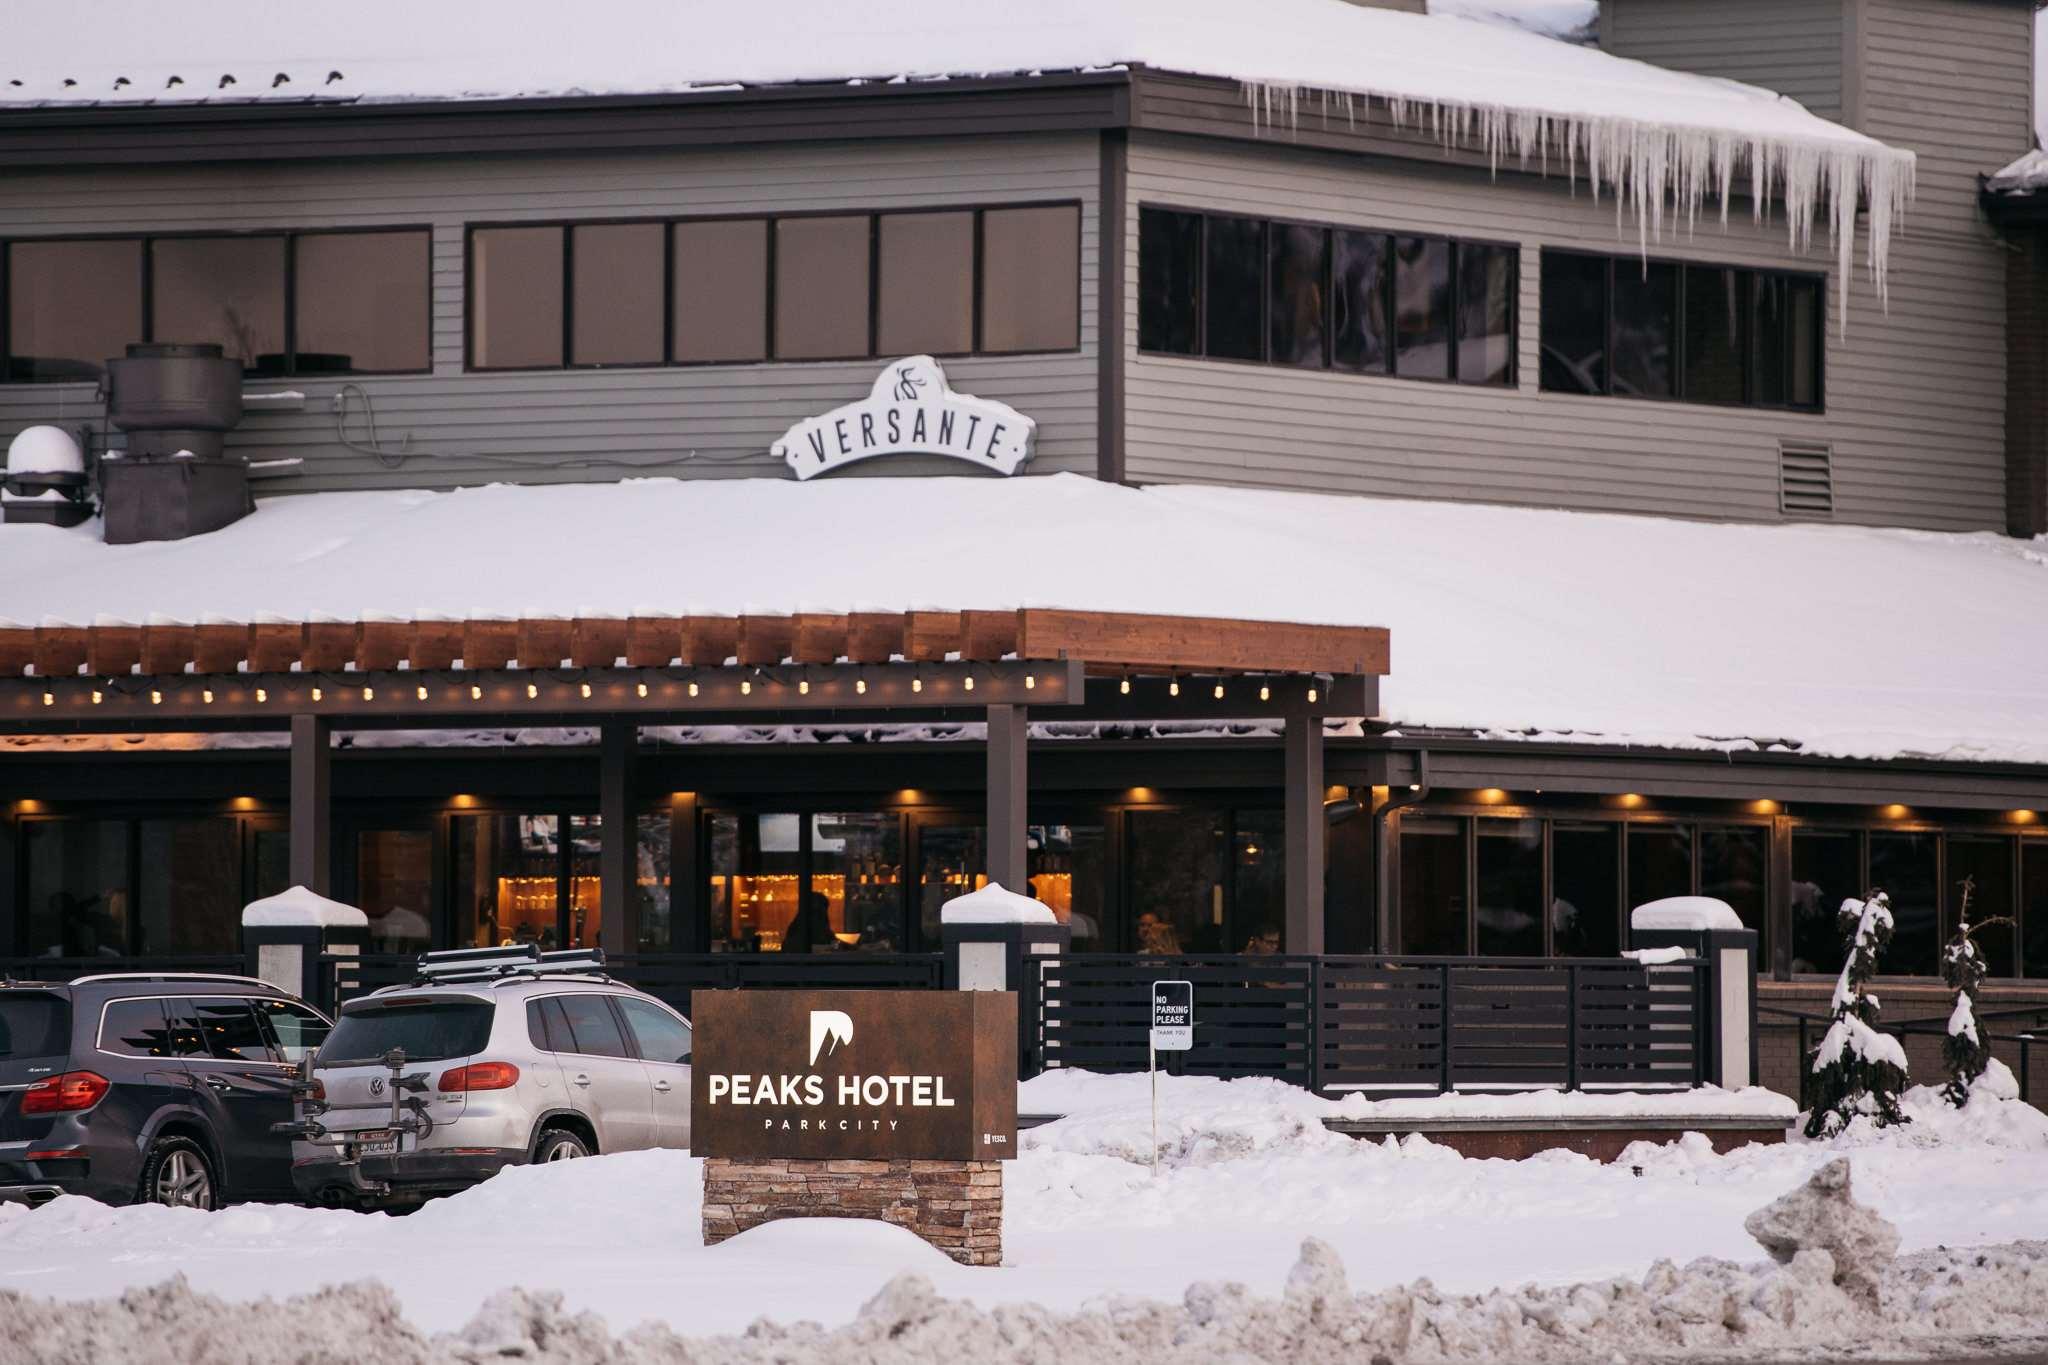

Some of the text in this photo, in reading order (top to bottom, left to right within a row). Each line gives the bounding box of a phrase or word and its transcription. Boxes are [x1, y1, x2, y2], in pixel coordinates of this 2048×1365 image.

[807, 407, 1006, 464] VERSANTE
[1156, 996, 1167, 1004] NO
[1156, 1005, 1189, 1014] PARKING
[1156, 1015, 1185, 1024] PLEASE
[709, 1074, 955, 1107] PEAKS HOTEL
